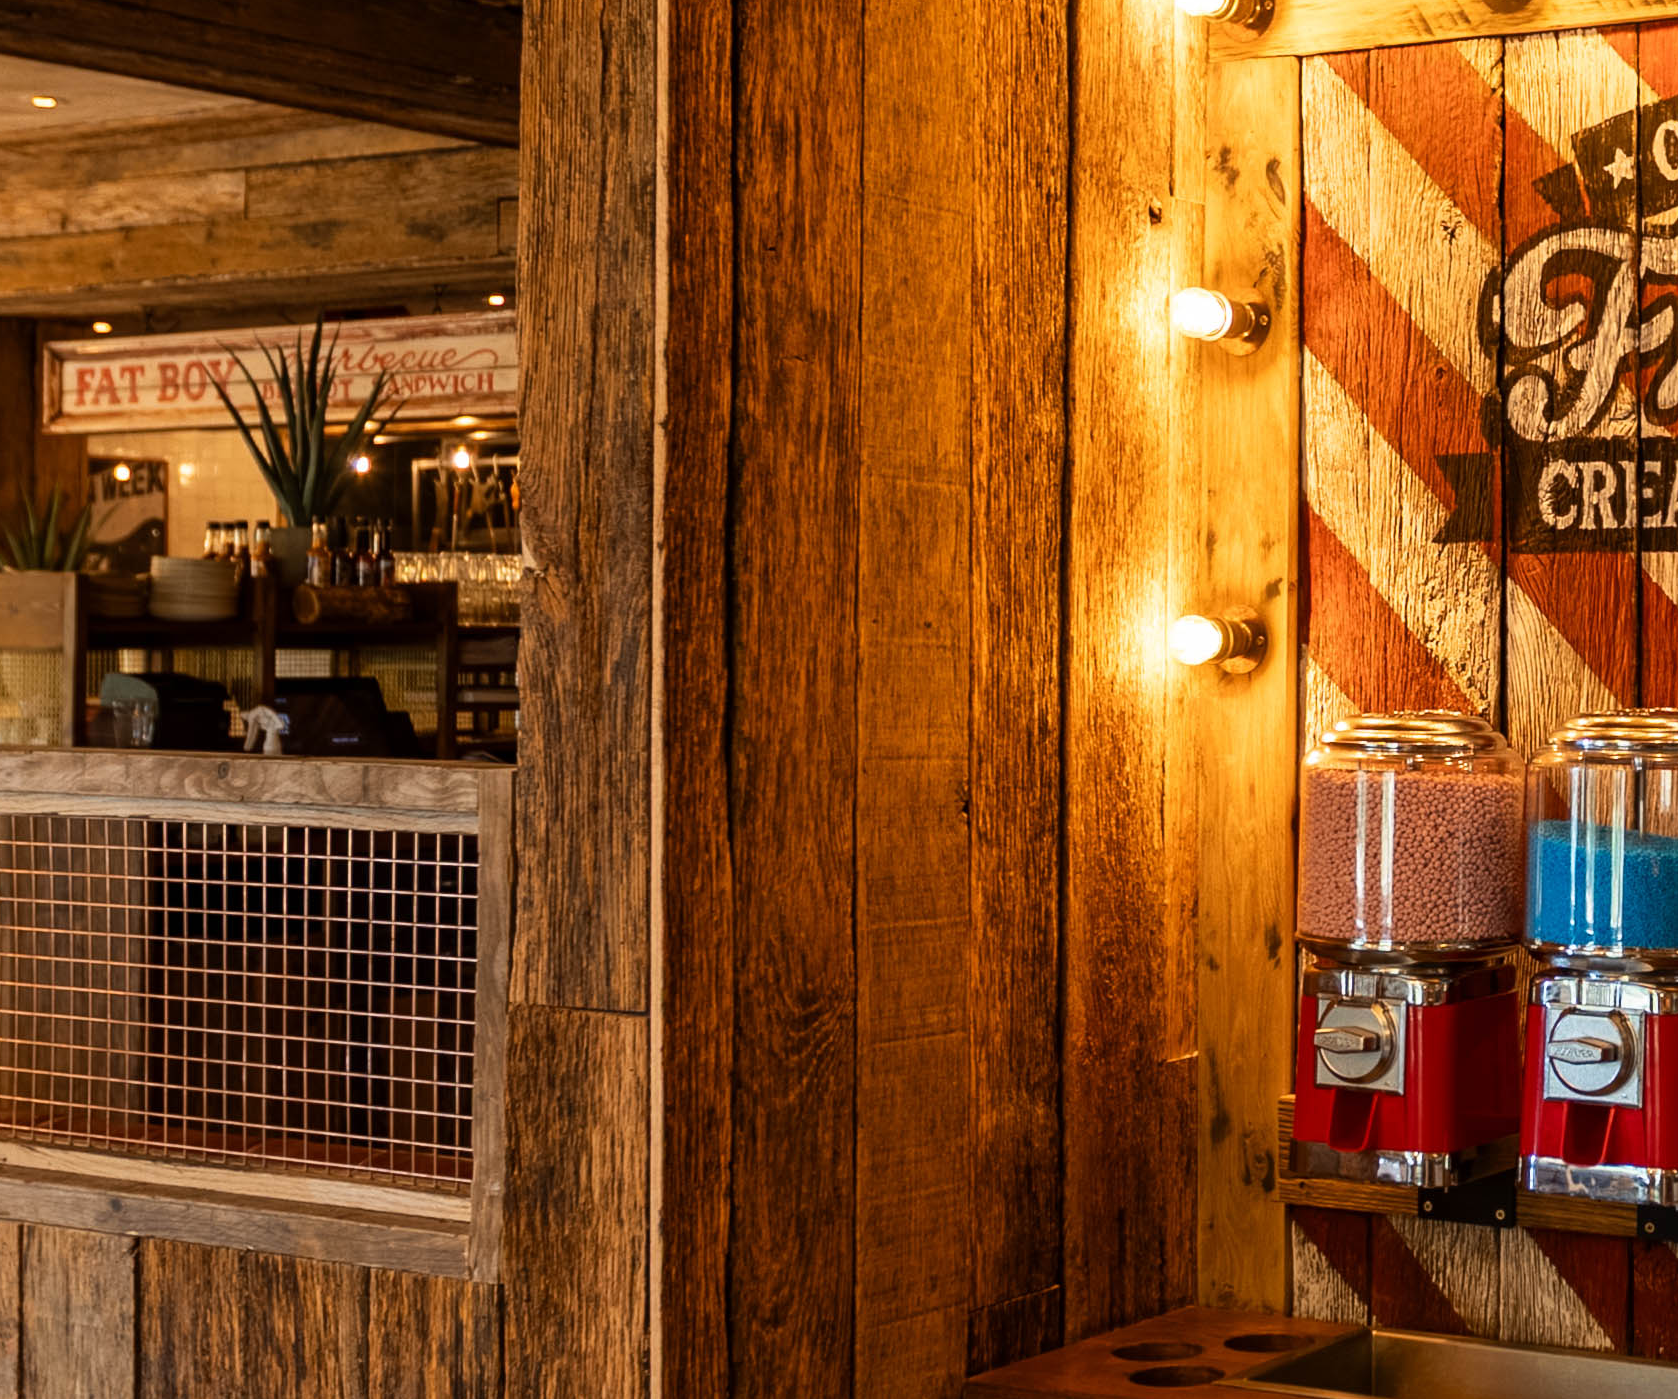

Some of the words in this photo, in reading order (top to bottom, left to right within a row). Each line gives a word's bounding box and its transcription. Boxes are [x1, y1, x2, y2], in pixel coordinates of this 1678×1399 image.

[75, 366, 144, 406] FAT
[157, 359, 236, 401] BOY
[372, 371, 493, 395] ANDWICH
